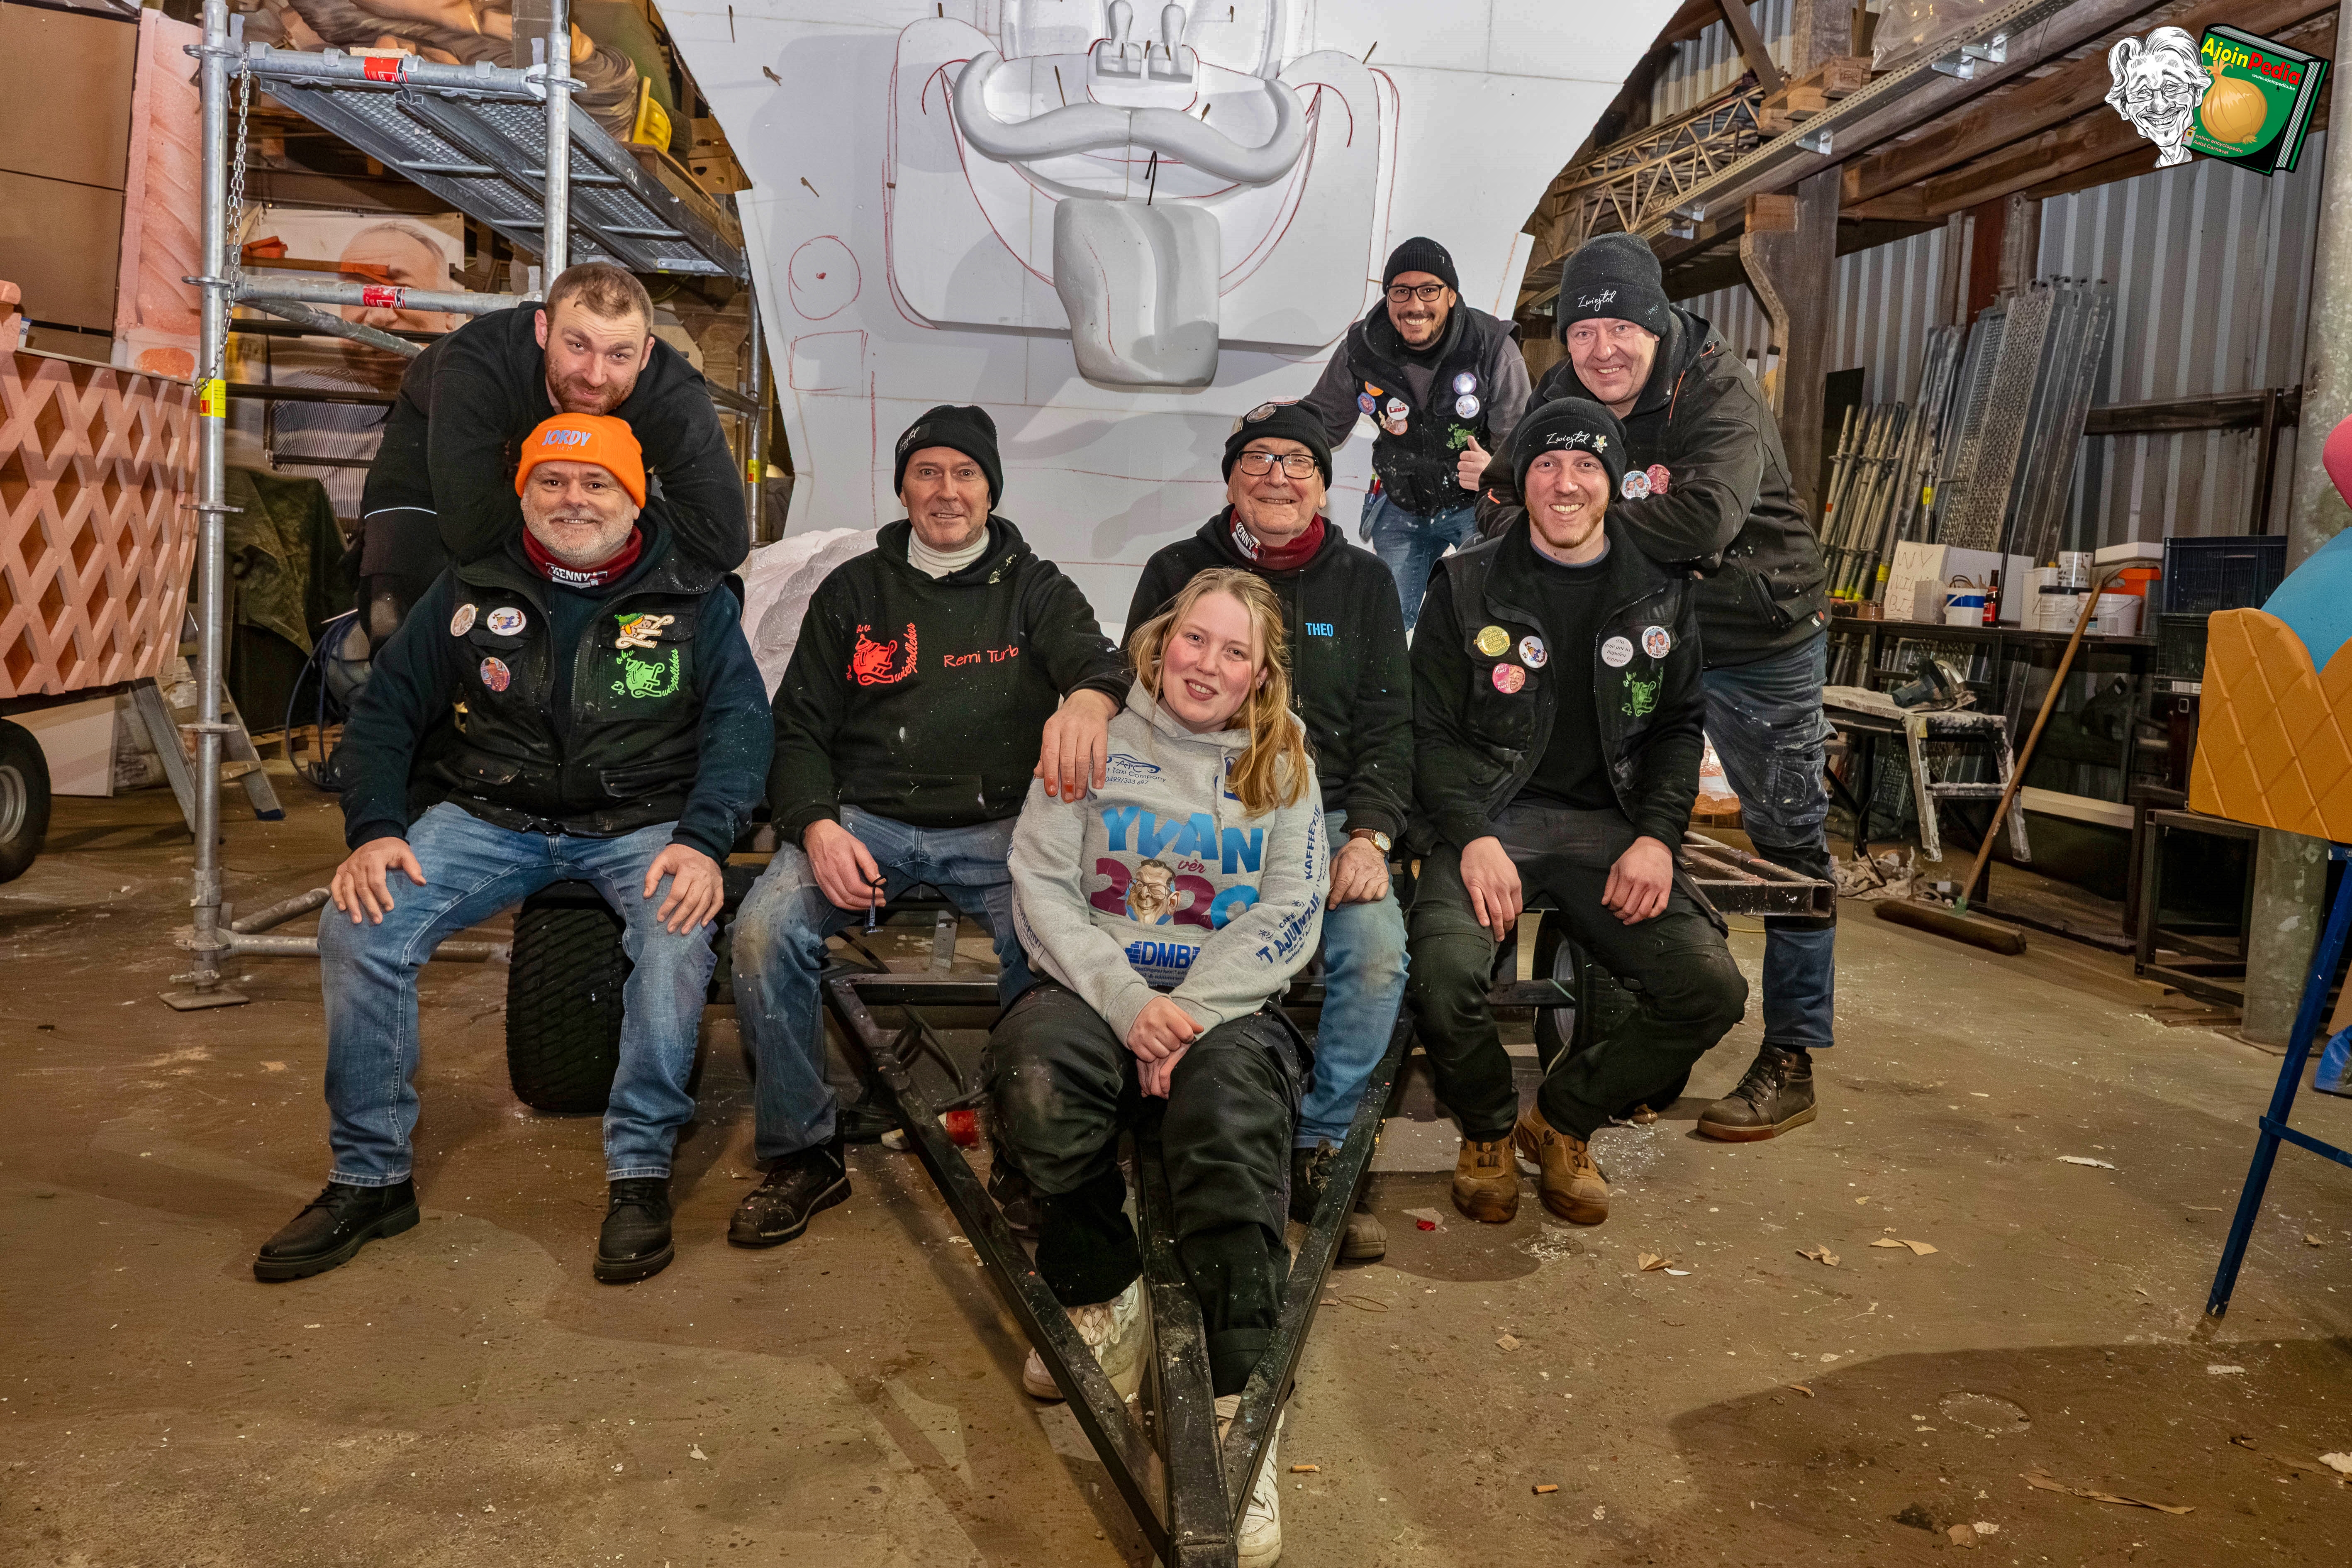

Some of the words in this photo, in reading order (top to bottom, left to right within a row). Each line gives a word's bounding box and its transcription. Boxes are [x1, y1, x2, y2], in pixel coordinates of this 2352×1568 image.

[542, 430, 592, 446] JORDY
[1236, 522, 1255, 551] KENNY
[551, 566, 591, 582] KENNY
[1305, 622, 1333, 637] THEO
[944, 651, 981, 668] Remi
[987, 644, 1019, 663] Turb
[1128, 771, 1167, 783] Company
[1102, 806, 1264, 875] YVAN
[1304, 804, 1321, 880] KAFFEETJE
[1178, 858, 1206, 874] vèr
[1255, 946, 1274, 964] 'T
[1274, 892, 1321, 957] AJUINTJE
[1279, 912, 1297, 929] CAFÉ
[1141, 941, 1191, 969] DMB
